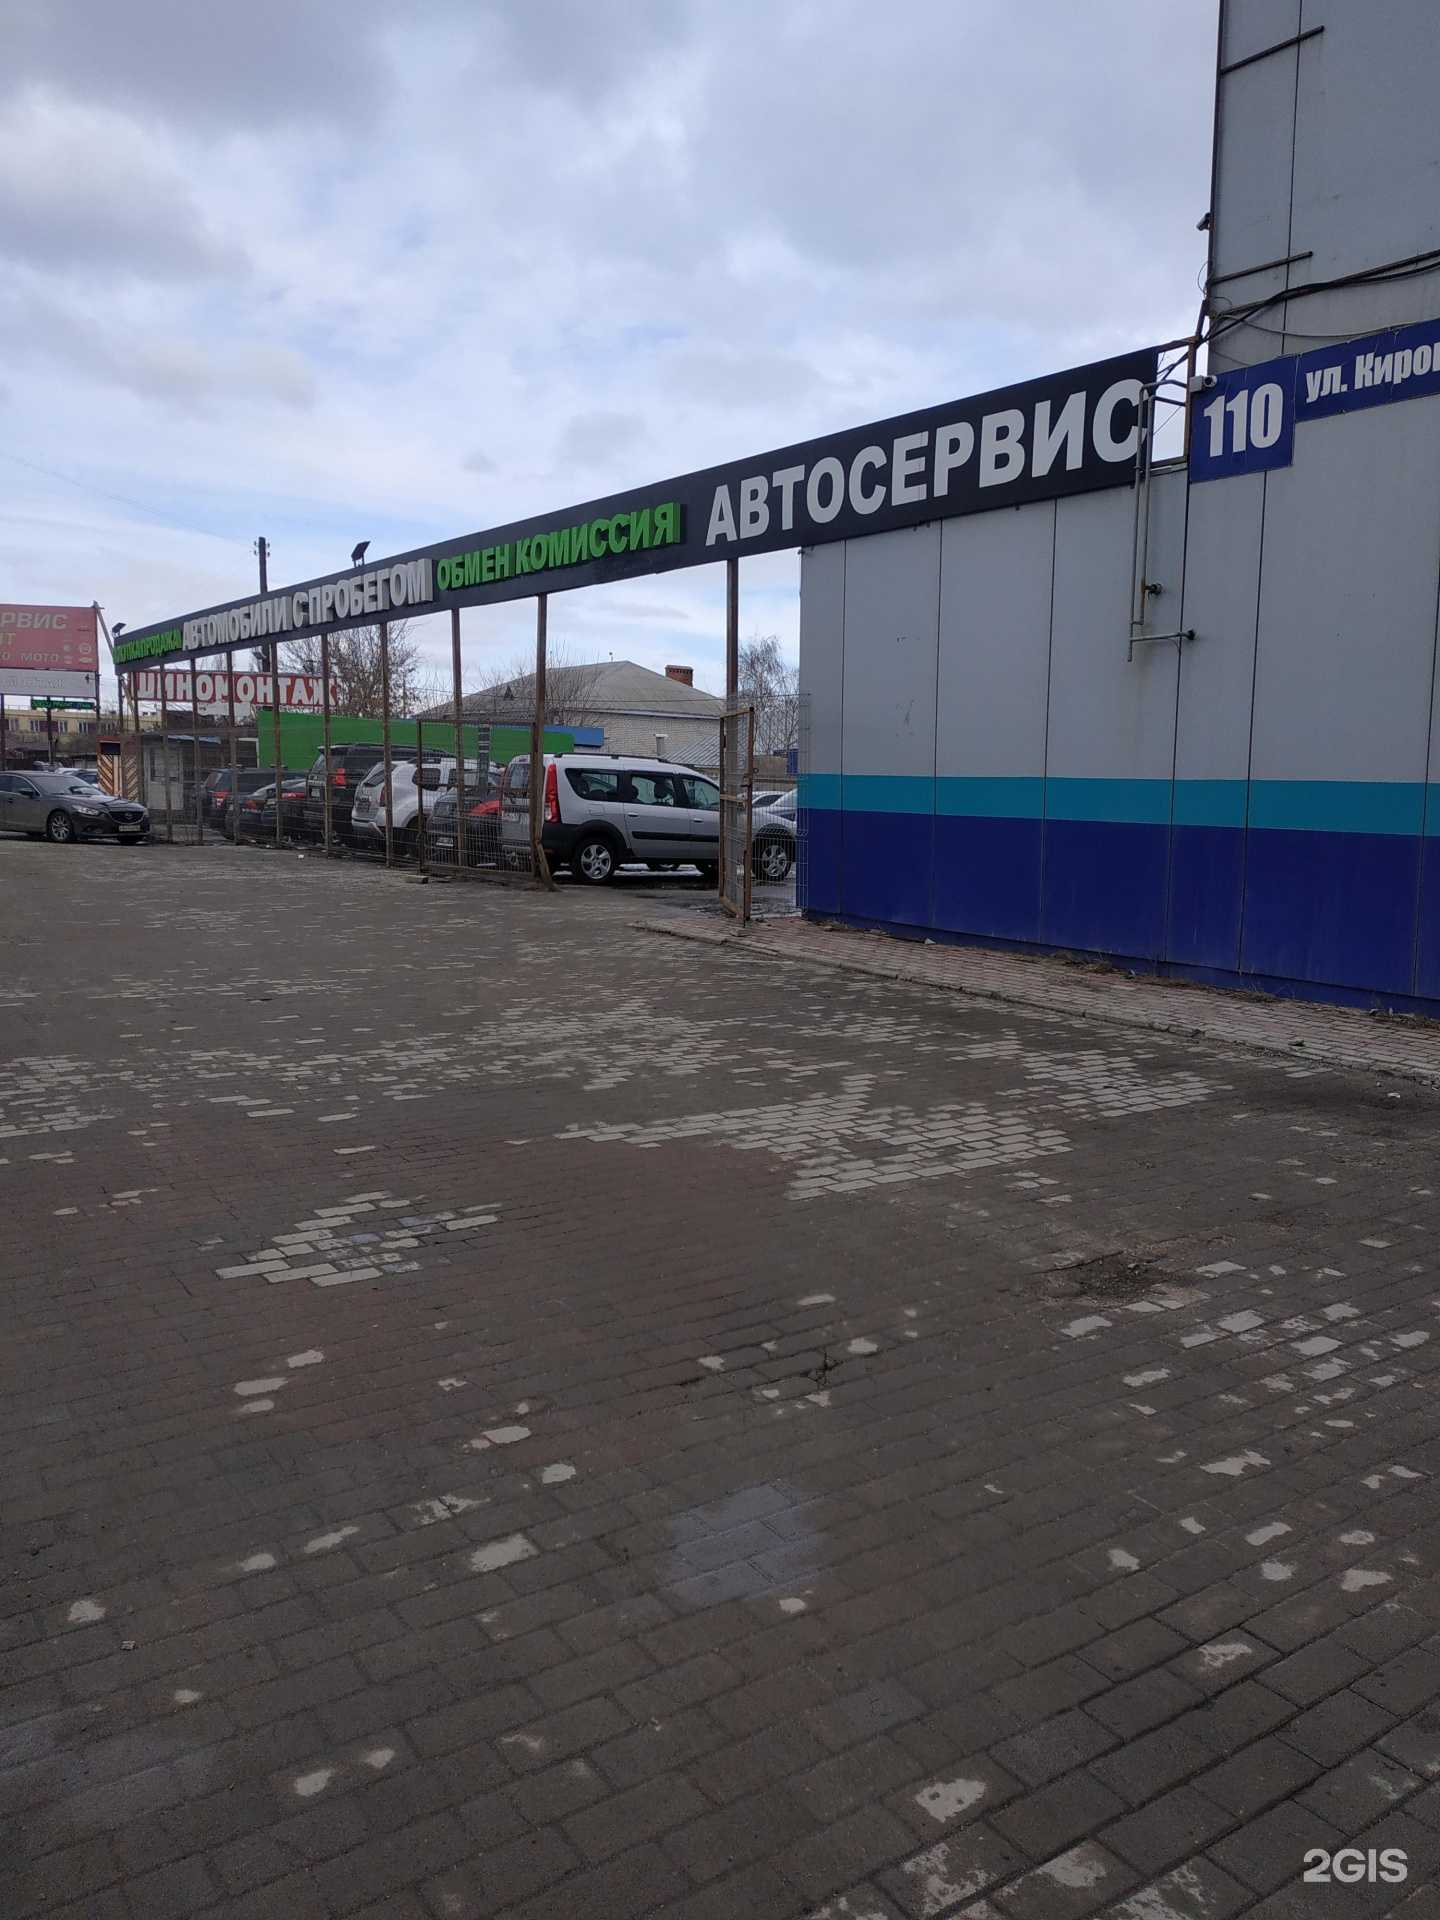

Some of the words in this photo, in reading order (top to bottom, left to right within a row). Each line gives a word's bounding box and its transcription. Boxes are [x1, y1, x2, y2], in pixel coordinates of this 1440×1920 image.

[1204, 383, 1284, 457] 110
[1305, 365, 1348, 403] ул.
[705, 378, 1149, 547] АВТОСЕРВИС
[437, 544, 515, 591] ОБМЕН
[515, 501, 682, 573] КОМИССИЯ
[182, 596, 293, 651] АВТОМОБИЛИ
[292, 591, 308, 628] С
[308, 558, 434, 625] ПРОБЕГОМ
[137, 671, 338, 706] ШИНОМОНТАЖ
